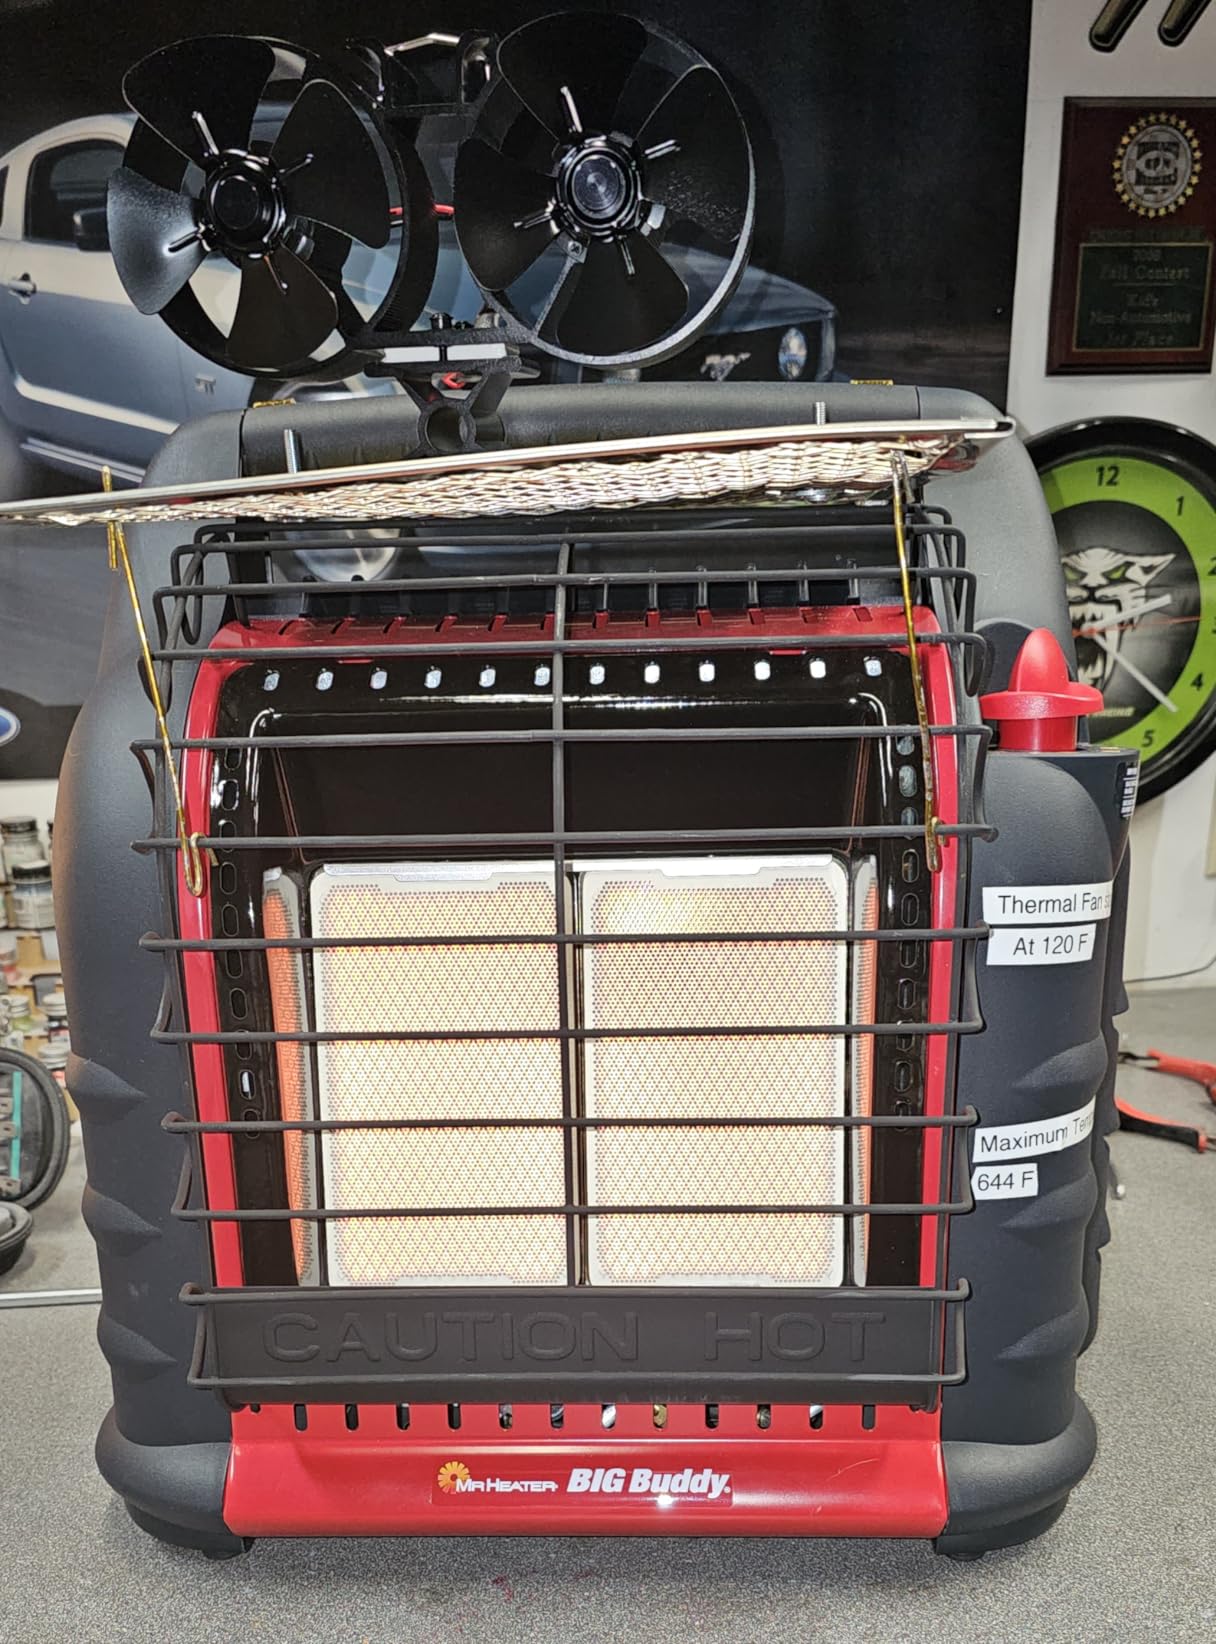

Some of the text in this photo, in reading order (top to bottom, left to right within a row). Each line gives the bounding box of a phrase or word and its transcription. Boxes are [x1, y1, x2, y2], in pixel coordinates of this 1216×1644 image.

[1096, 464, 1120, 487] 12
[1175, 496, 1184, 516] 1
[1190, 672, 1205, 692] 4
[1142, 729, 1155, 748] 5
[997, 893, 1077, 914] Thermal
[1082, 892, 1102, 911] Fan
[1013, 933, 1089, 955] At 120 F
[981, 1126, 1068, 1153] Maximum
[977, 1170, 1035, 1192] 644 F
[261, 1310, 888, 1364] CAUTION HOT
[566, 1468, 626, 1493] BIG
